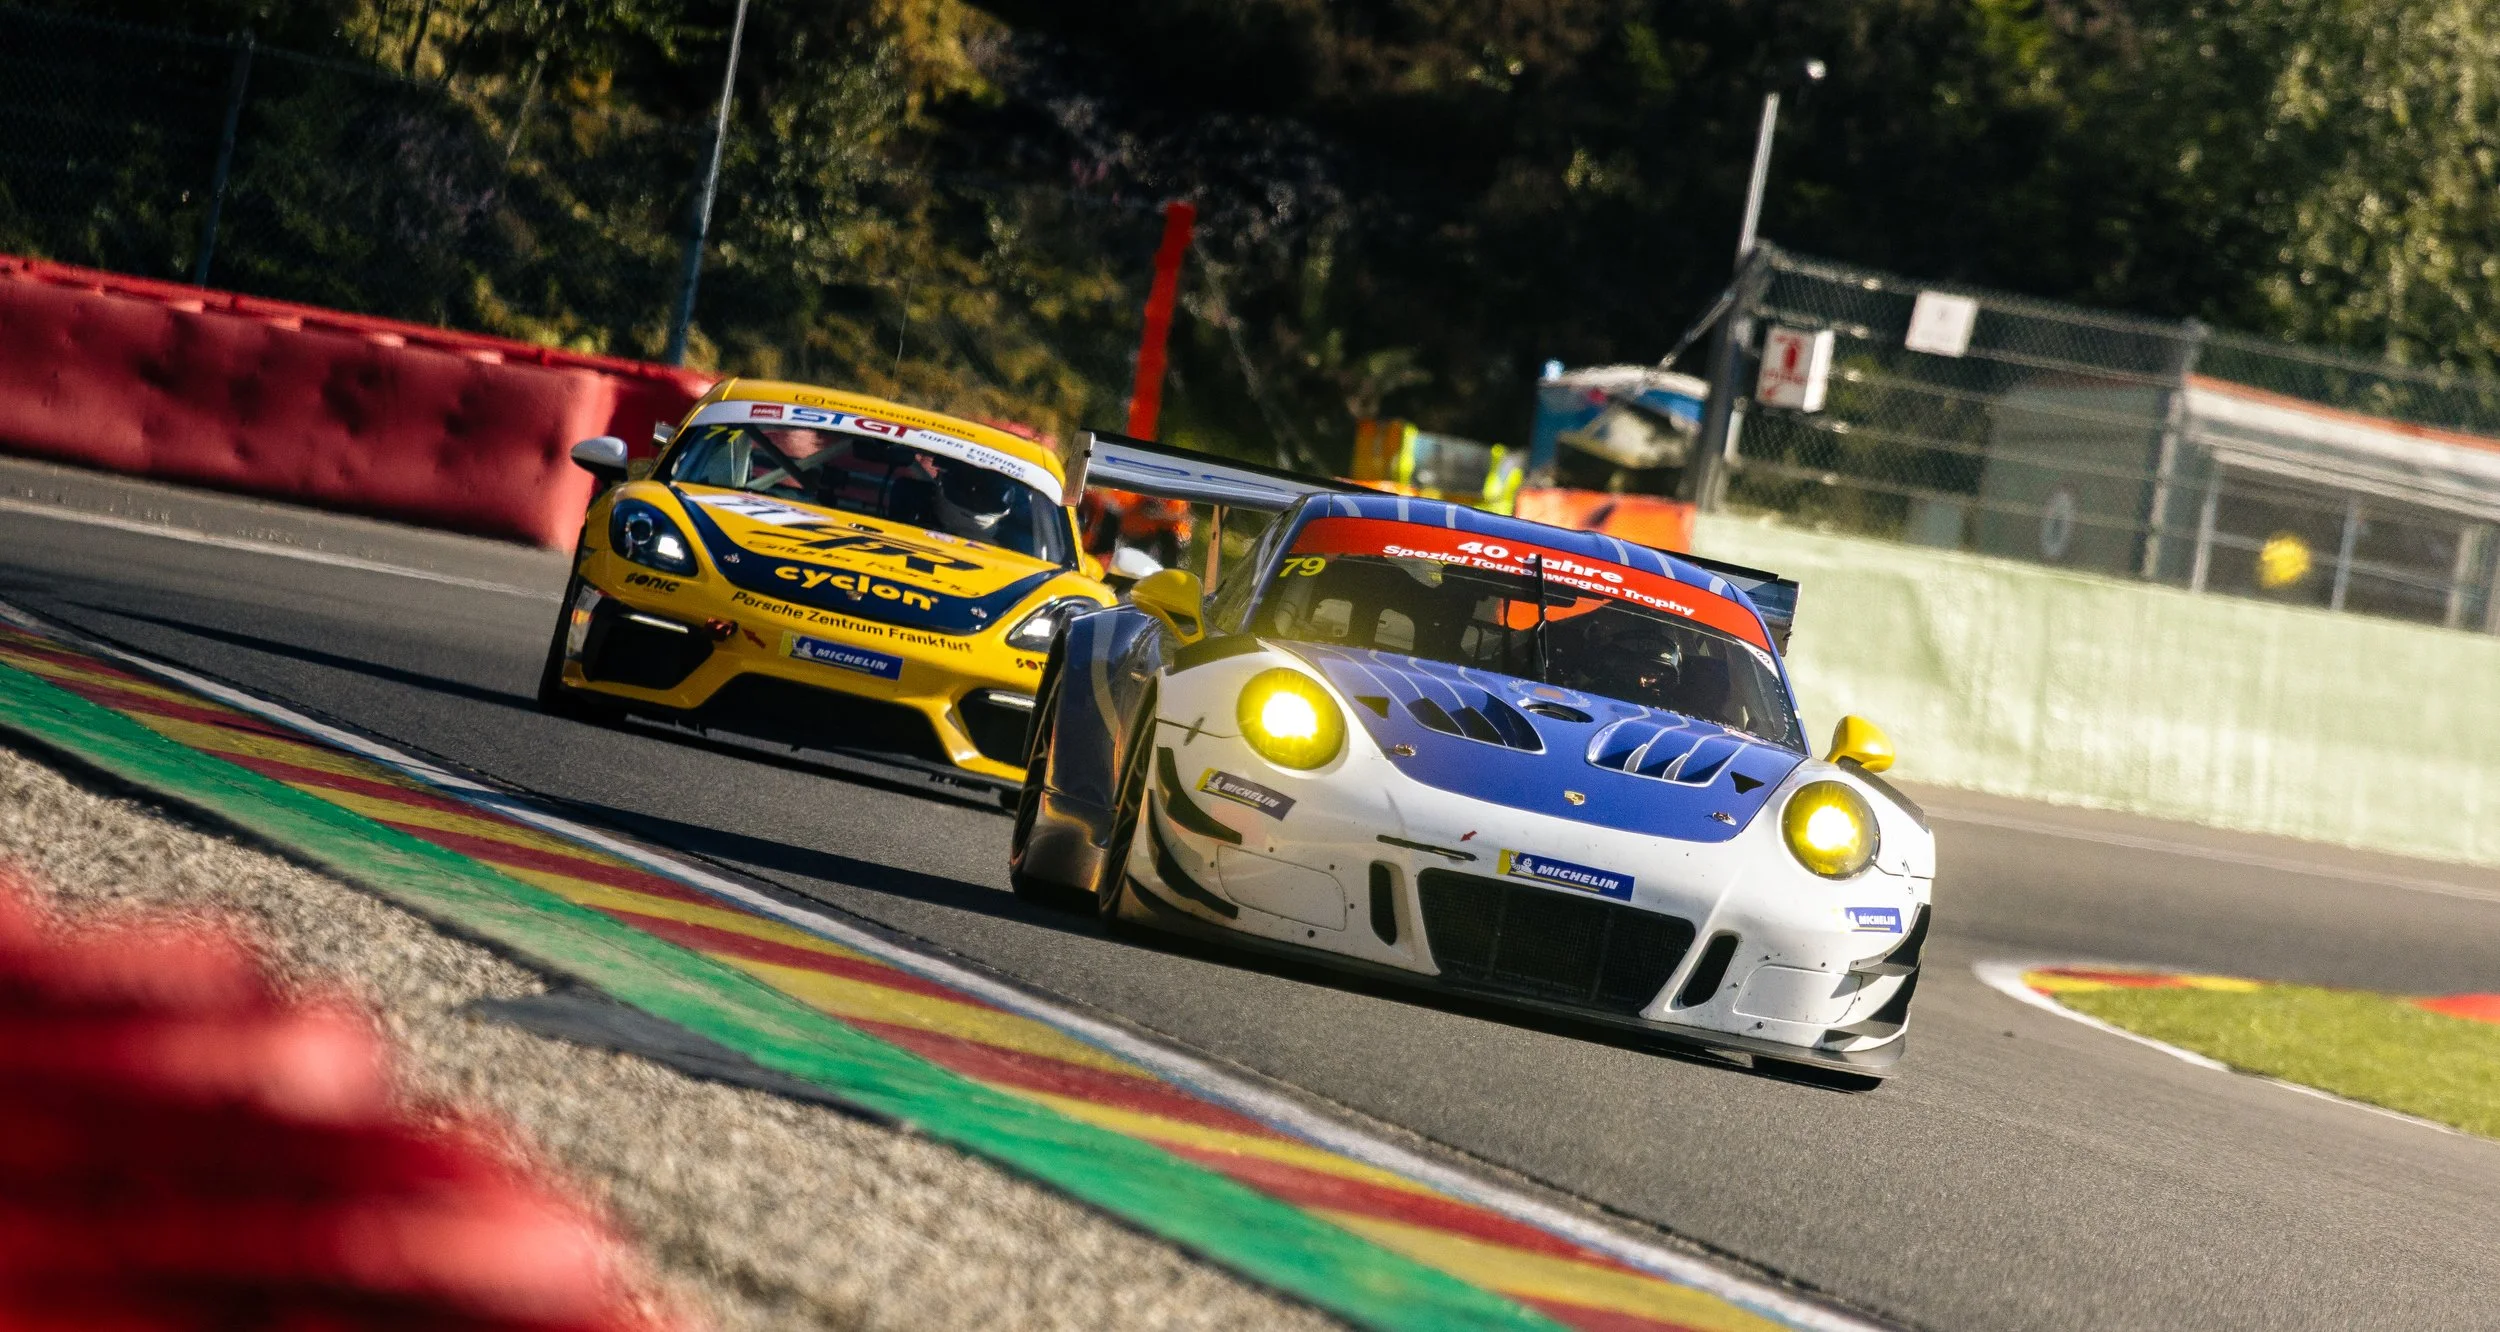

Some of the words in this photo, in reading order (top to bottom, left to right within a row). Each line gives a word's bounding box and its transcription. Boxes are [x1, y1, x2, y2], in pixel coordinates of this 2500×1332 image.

[1278, 556, 1327, 578] 79
[1457, 541, 1509, 559] 40
[1514, 552, 1624, 584] Jahre
[775, 566, 933, 610] cyclon
[1382, 545, 1469, 565] Spezial
[1622, 587, 1696, 617] Trophy
[731, 590, 804, 620] Porsche
[807, 610, 884, 637] Zentrum
[888, 627, 973, 655] Frankfurt
[815, 647, 889, 671] MICHELIN
[1220, 782, 1280, 809] MICHELIN
[1536, 864, 1619, 890] MICHELIN
[1858, 915, 1896, 926] MICHELIN
